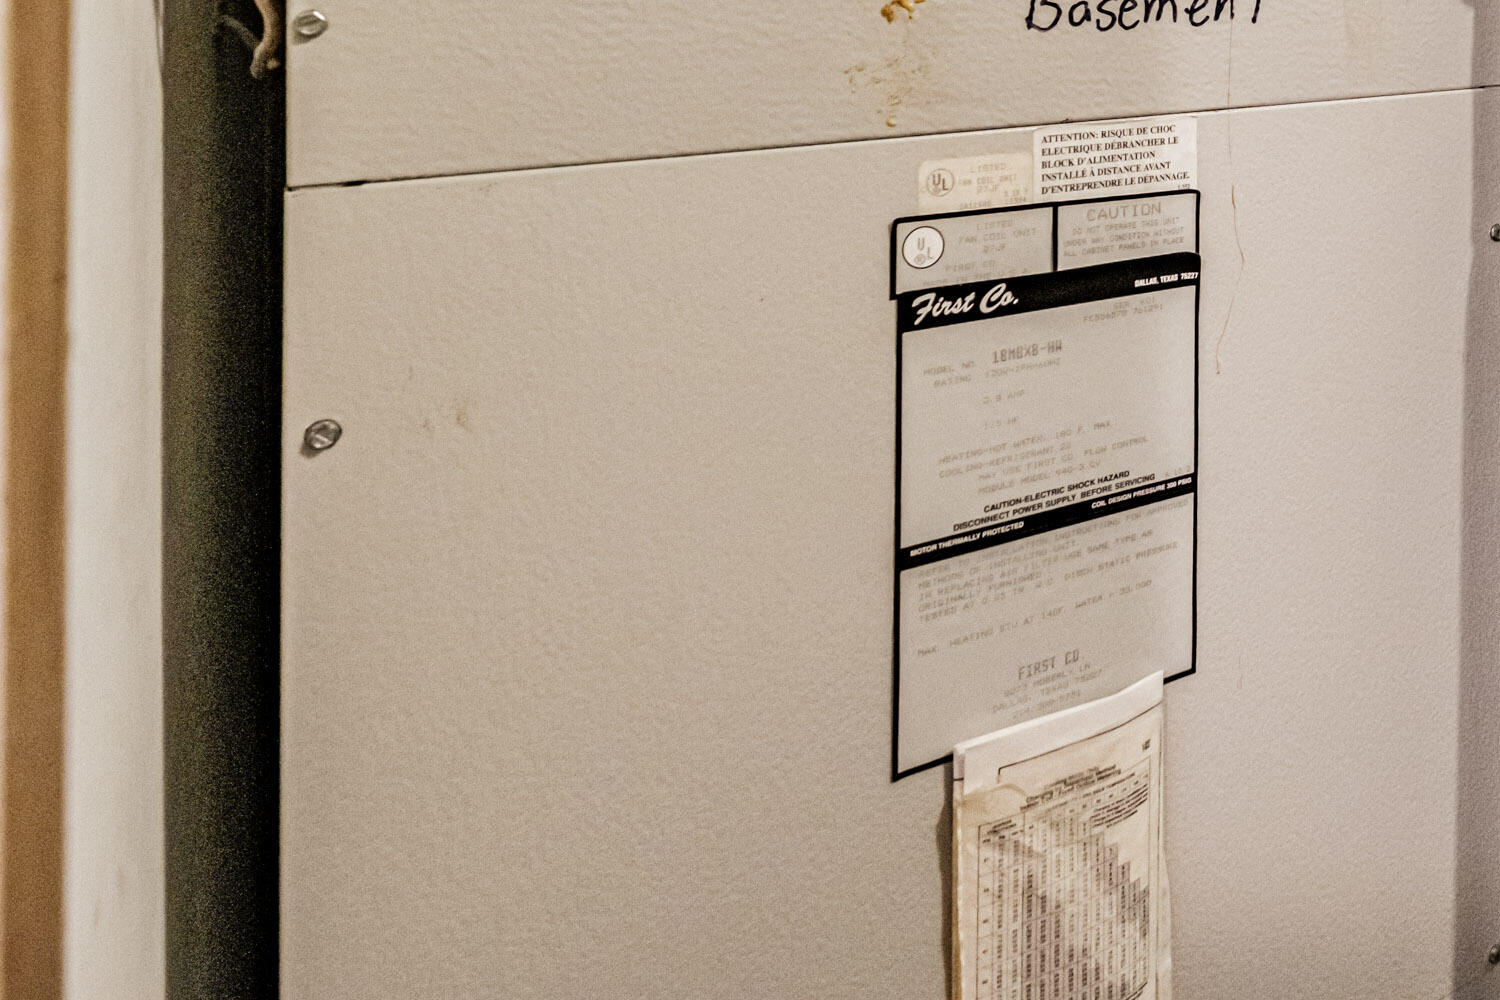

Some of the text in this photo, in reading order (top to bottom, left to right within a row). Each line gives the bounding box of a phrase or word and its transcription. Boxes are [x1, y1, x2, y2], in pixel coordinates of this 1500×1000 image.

[1042, 124, 1176, 144] ATTENTION: RISQUE DE CHOC
[1104, 137, 1166, 150] DÉBRANCHER
[1168, 136, 1178, 144] LE
[1042, 151, 1156, 169] BLOCK D'ALIMENTATION
[1042, 167, 1086, 182] INSTALLÉ
[1098, 164, 1142, 176] DISTANCE
[1144, 161, 1171, 171] AVANT
[1042, 179, 1122, 195] D'ENTREPRENDRE
[1124, 176, 1136, 185] LE
[1086, 202, 1162, 222] CAUTION
[1134, 276, 1159, 288] DALLAS,
[1160, 274, 1178, 284] TEXAS
[911, 283, 1019, 326] First Co.
[1066, 479, 1096, 493] SHOCK
[1097, 470, 1130, 486] HAZARD
[953, 472, 1156, 532] DISCONNECT POWER SUPPLY BEFORE SERVICING
[910, 544, 938, 557] MOTOR
[938, 532, 981, 550] THERMALLY
[982, 520, 1024, 538] PROTECTED
[1091, 499, 1106, 510] COIL
[1108, 492, 1132, 506] DESIGN
[1133, 482, 1165, 498] PRESSURE
[1178, 476, 1192, 488] PSIG
[1018, 656, 1056, 681] FIRST
